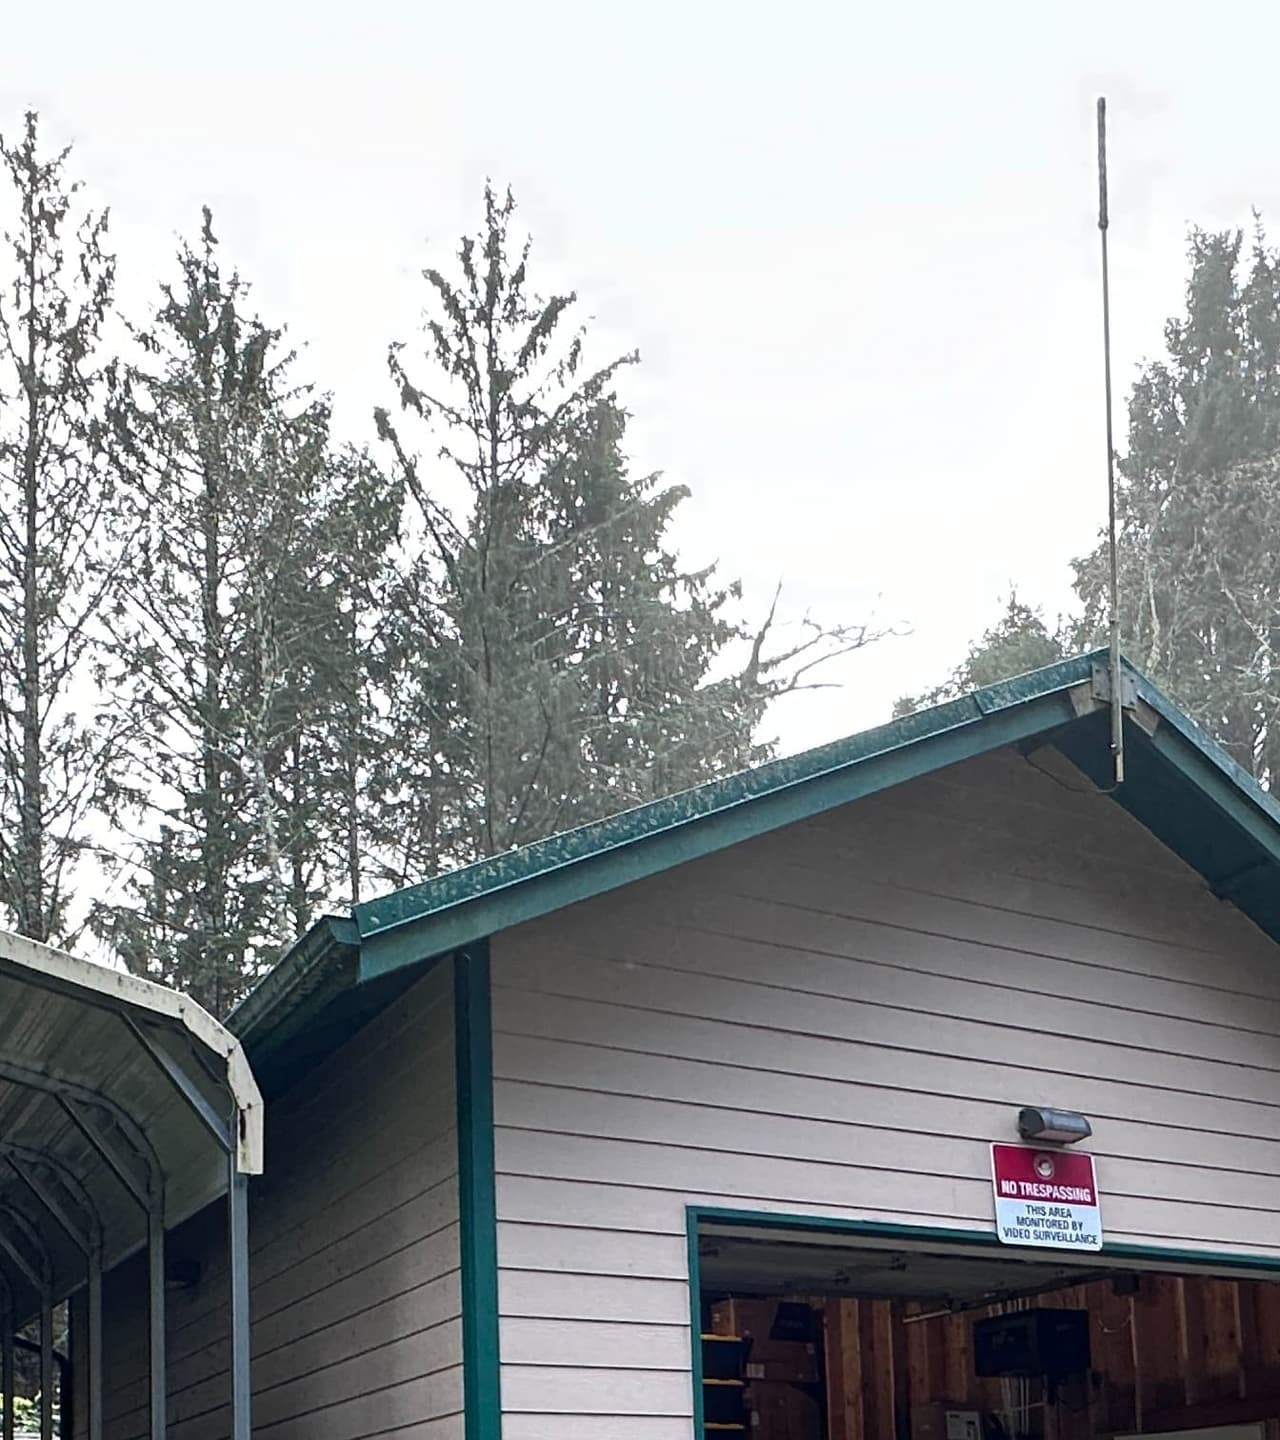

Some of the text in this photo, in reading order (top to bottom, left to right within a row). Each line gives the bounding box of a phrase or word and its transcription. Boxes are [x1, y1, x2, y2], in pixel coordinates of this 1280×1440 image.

[1001, 1180, 1091, 1202] NO TRESPASSING
[1026, 1205, 1072, 1218] THIS AREA
[1016, 1216, 1083, 1231] MONITORED BY
[1003, 1228, 1098, 1245] VIDEO SURVEILLANCE
